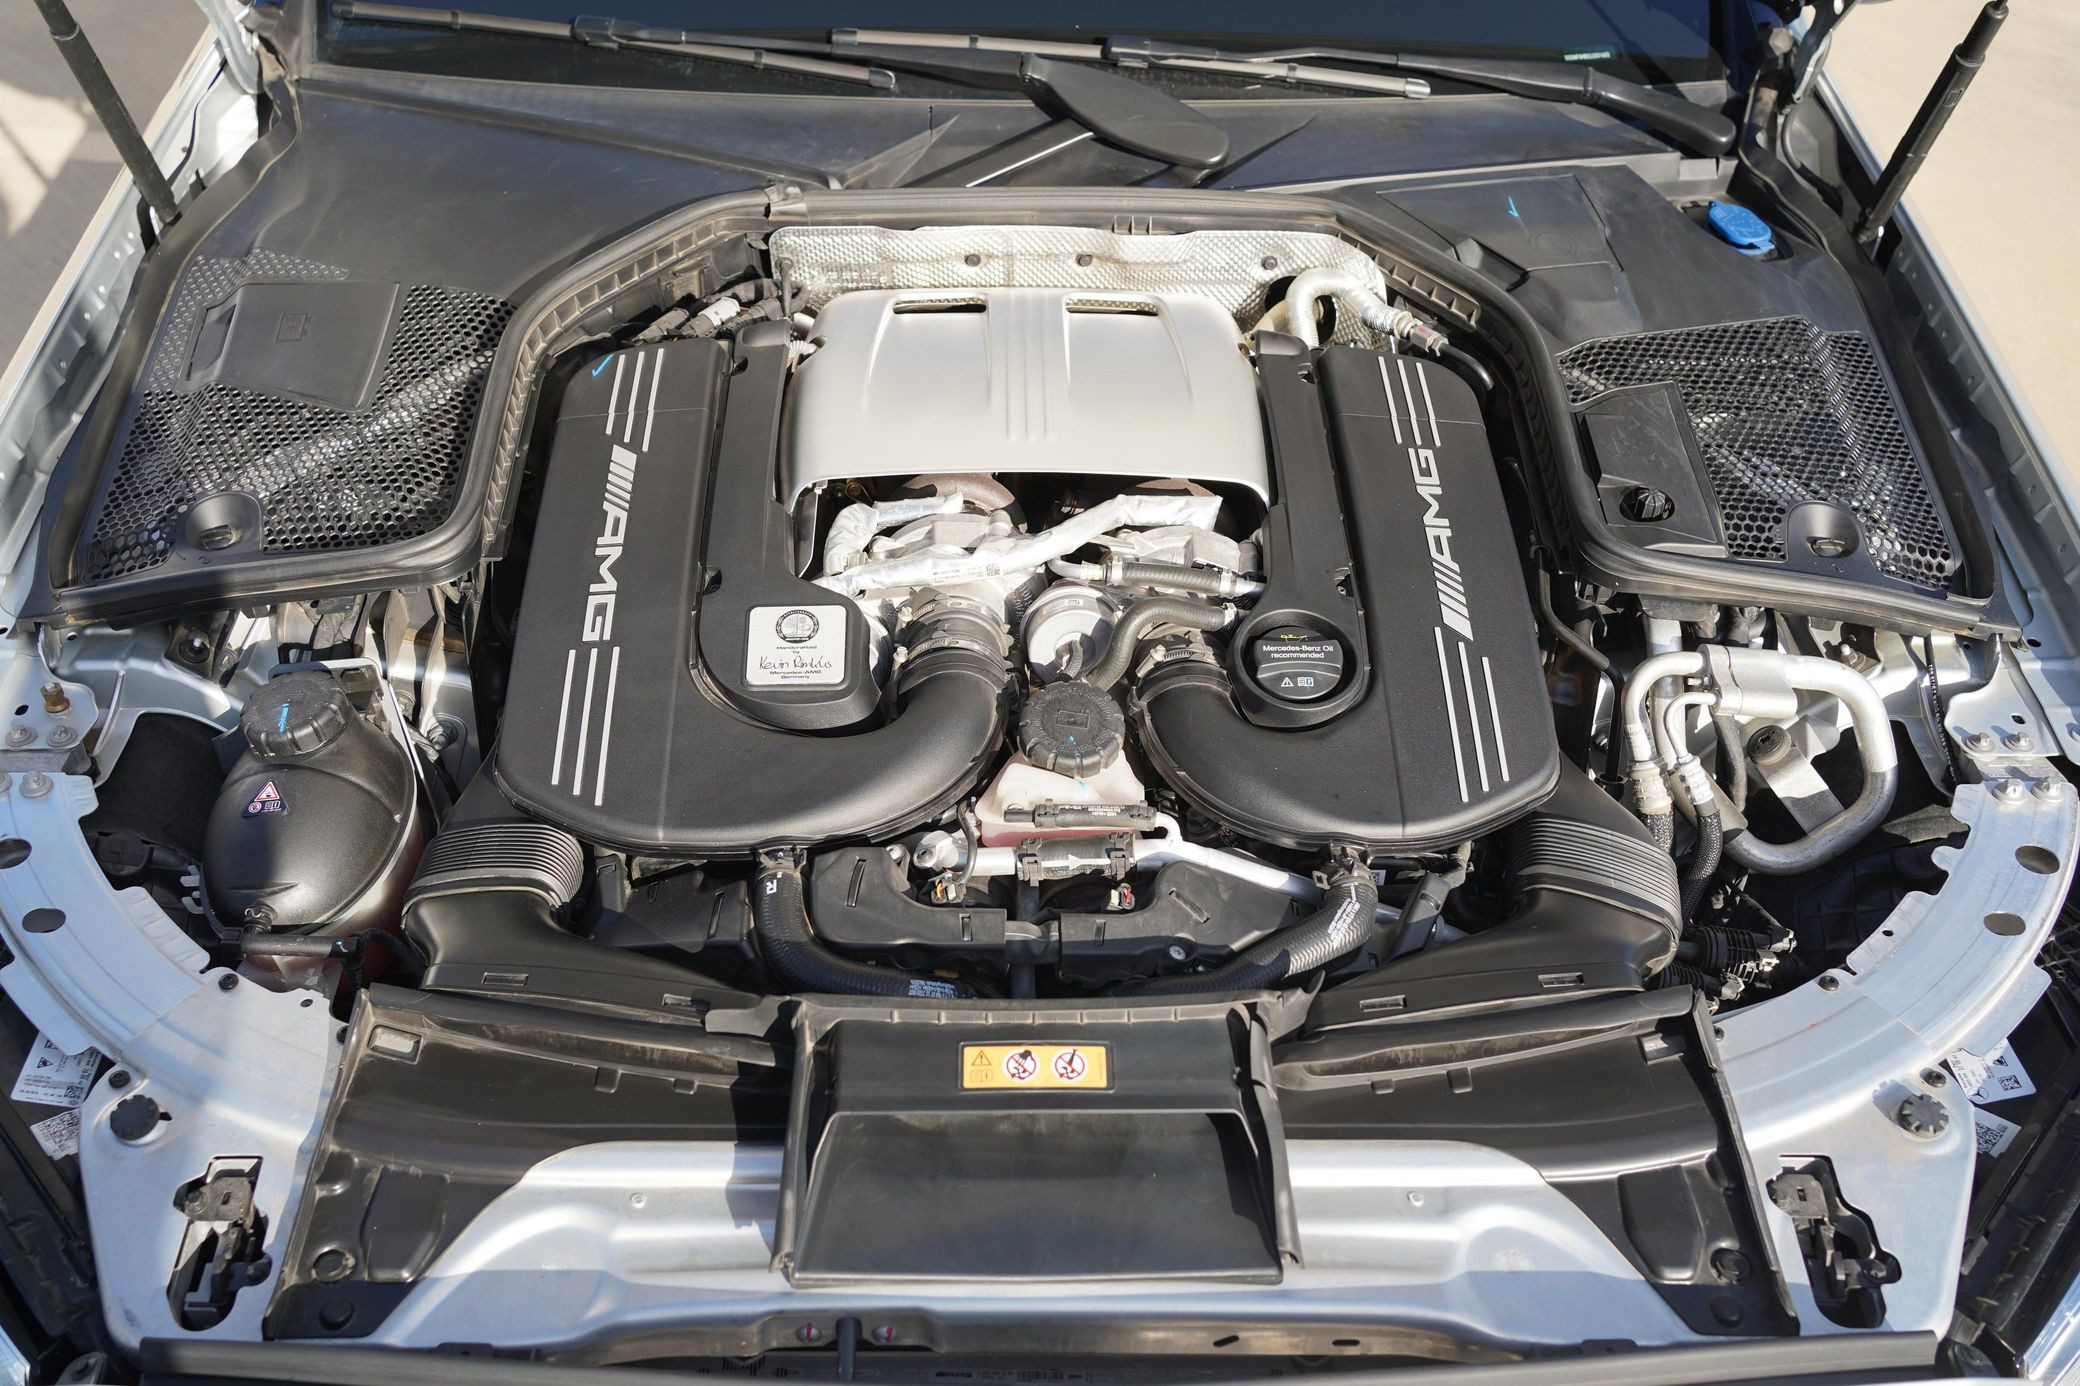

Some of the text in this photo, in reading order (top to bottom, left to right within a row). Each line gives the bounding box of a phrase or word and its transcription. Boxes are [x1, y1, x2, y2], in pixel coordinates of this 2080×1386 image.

[1408, 447, 1460, 574] AMG
[582, 500, 629, 642] AMG
[759, 656, 789, 670] Kevin
[1262, 644, 1321, 652] Mercedes-Benz
